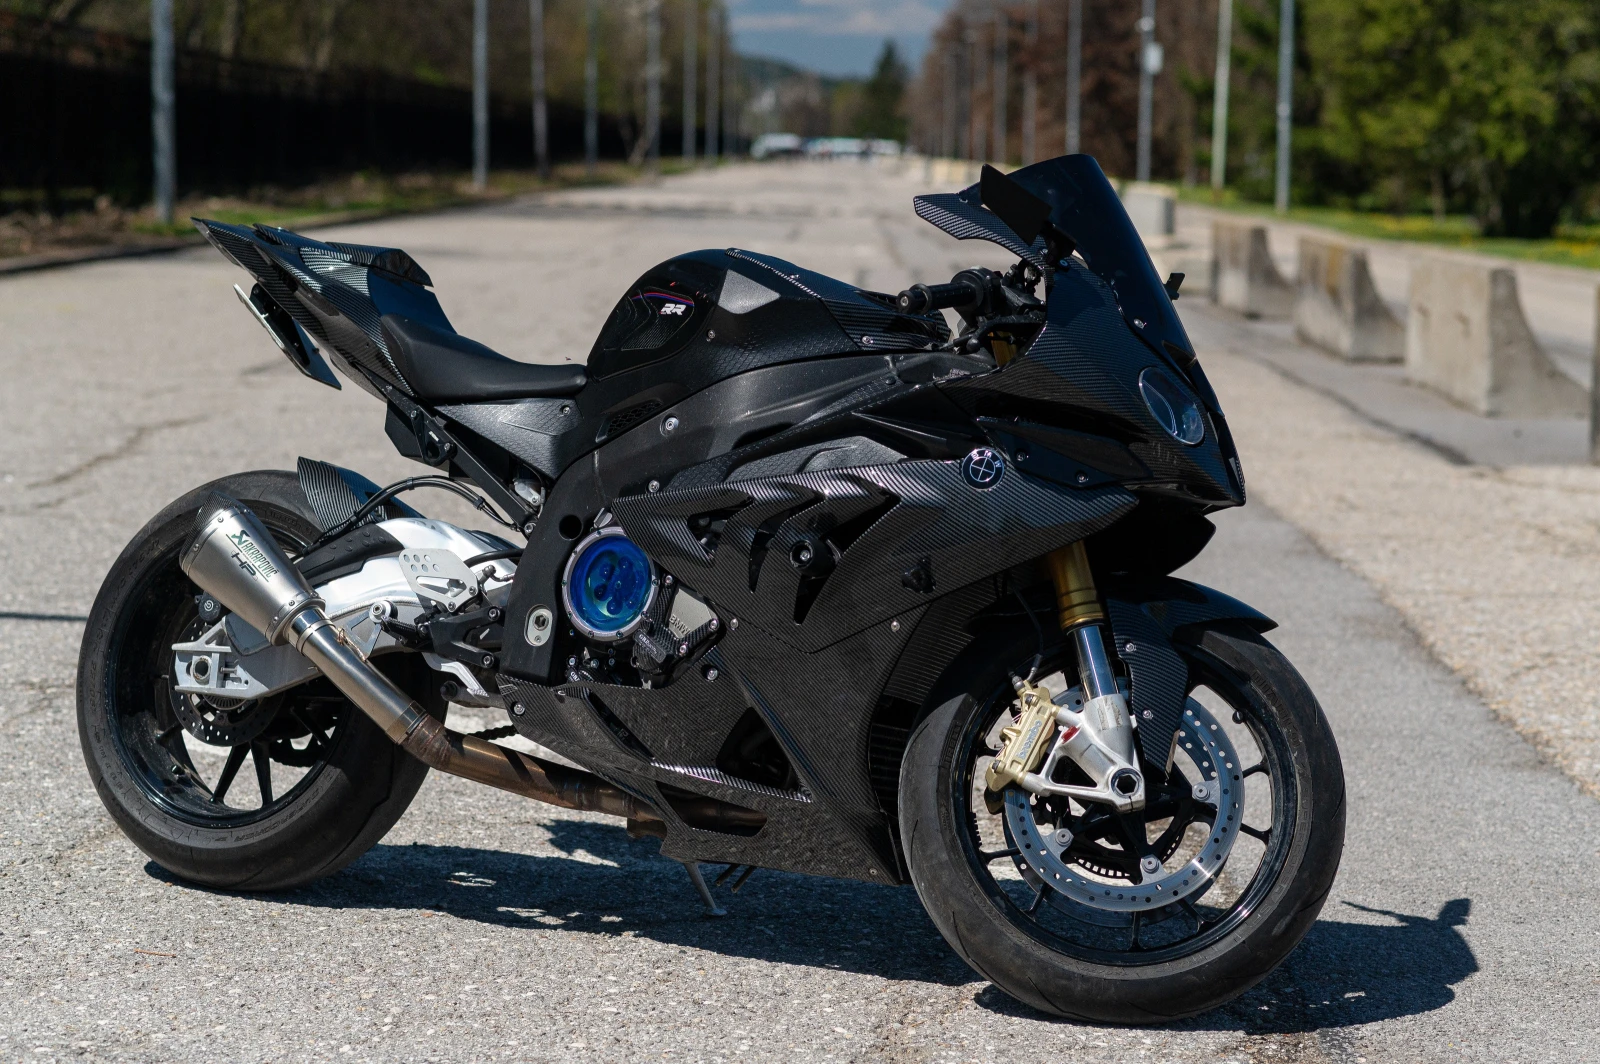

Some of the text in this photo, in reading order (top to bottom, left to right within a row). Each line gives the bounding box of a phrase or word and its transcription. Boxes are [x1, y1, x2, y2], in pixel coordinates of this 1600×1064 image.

[660, 303, 687, 316] RR
[970, 449, 1002, 468] BMW
[231, 552, 257, 576] HP
[669, 613, 691, 634] BMW
